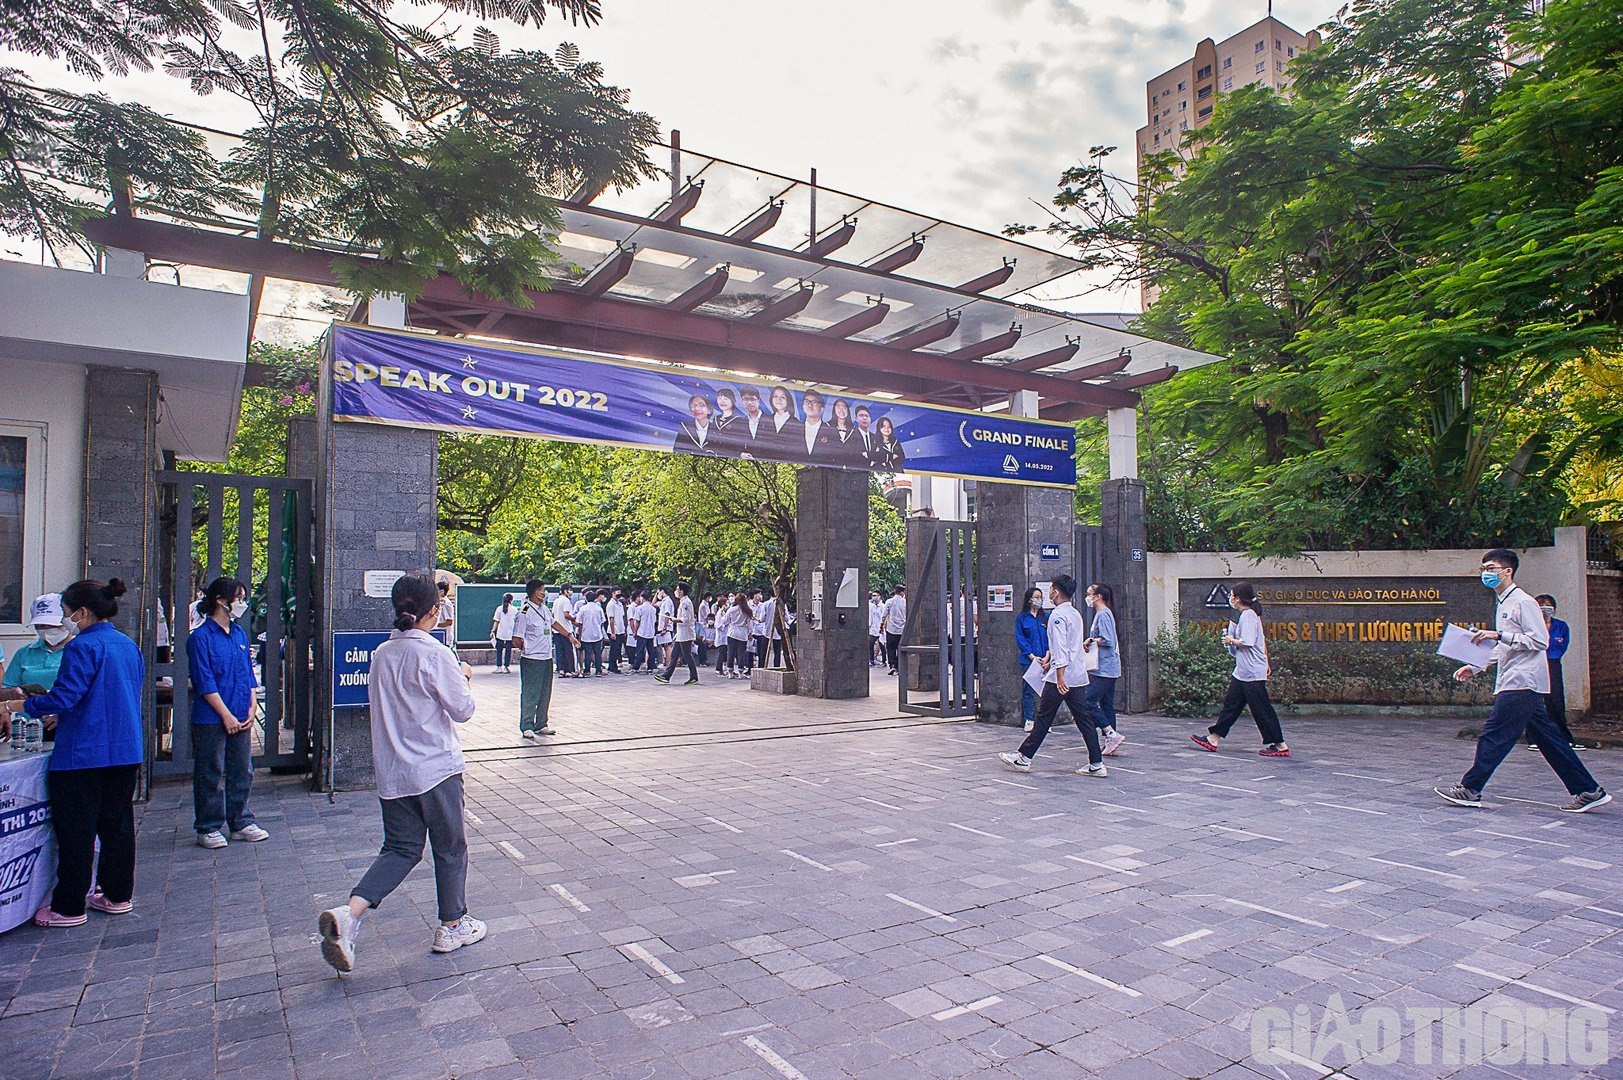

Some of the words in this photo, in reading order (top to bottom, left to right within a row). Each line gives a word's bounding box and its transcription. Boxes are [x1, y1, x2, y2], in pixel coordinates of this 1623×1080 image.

[332, 360, 453, 393] SPEAK
[461, 376, 530, 402] OUT
[537, 386, 609, 412] 2022
[972, 429, 1022, 445] GRAND
[1025, 435, 1069, 451] FINALE
[1024, 462, 1054, 471] 14.05.2022
[1133, 550, 1141, 560] 35
[1348, 587, 1372, 600] ĐÀO
[1375, 590, 1399, 601] TẠO
[1401, 587, 1418, 599] HÀ
[1419, 587, 1440, 601] NỘI
[1262, 621, 1298, 641] HCS
[1301, 622, 1312, 640] &
[1315, 622, 1355, 641] THPT
[1360, 620, 1412, 641] LƯƠNG
[1414, 616, 1444, 641] THẾ
[345, 647, 368, 662] CẢM
[1, 813, 26, 832] THI
